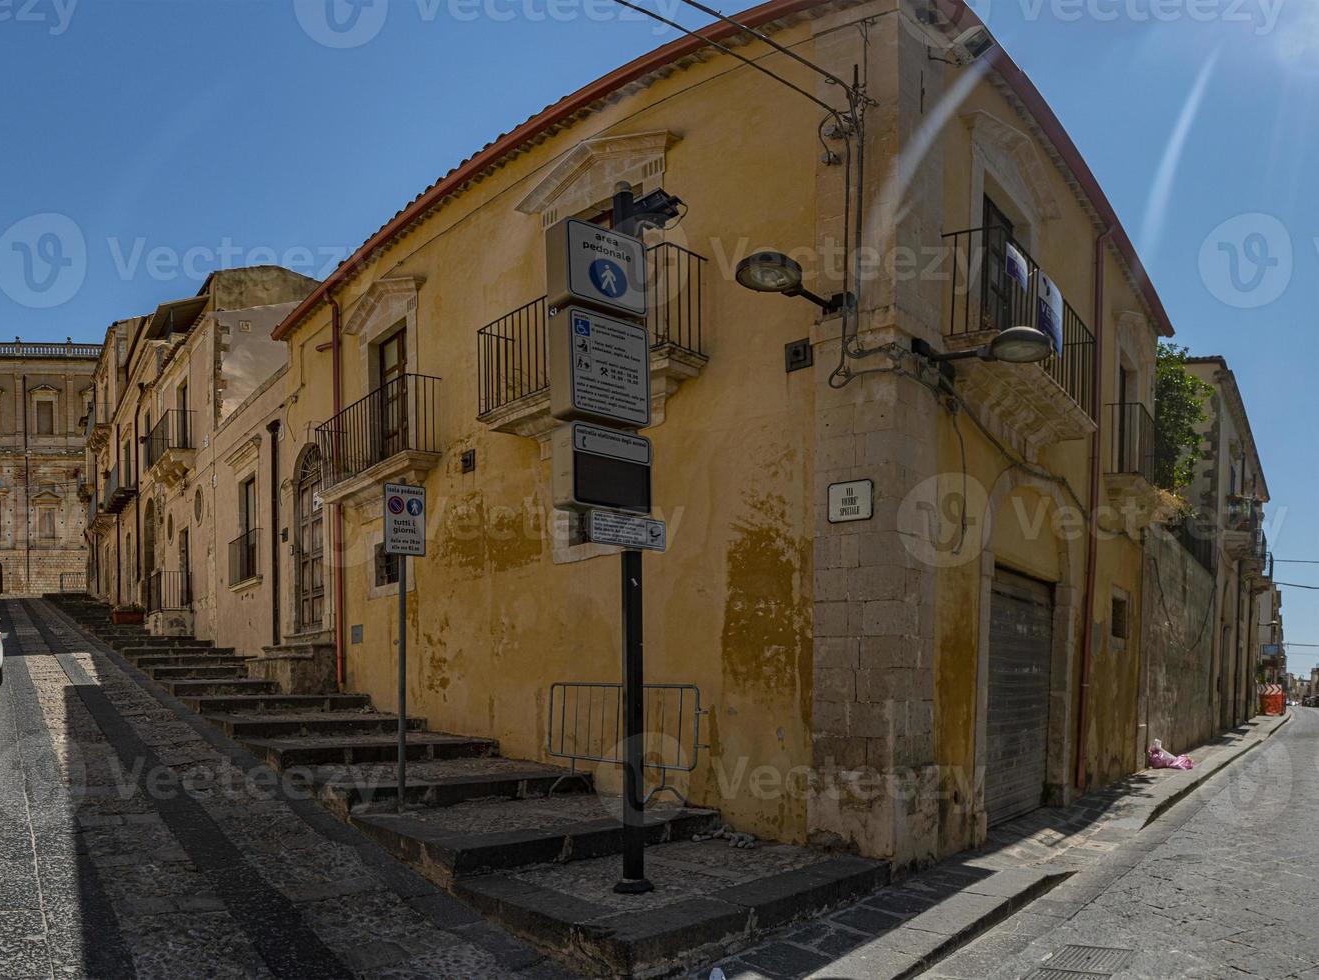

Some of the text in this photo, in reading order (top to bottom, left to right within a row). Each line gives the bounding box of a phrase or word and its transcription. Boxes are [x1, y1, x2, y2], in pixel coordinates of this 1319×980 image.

[595, 233, 618, 247] area
[583, 241, 632, 263] pedonale
[846, 488, 854, 496] VIA
[839, 506, 859, 516] SPECIALE
